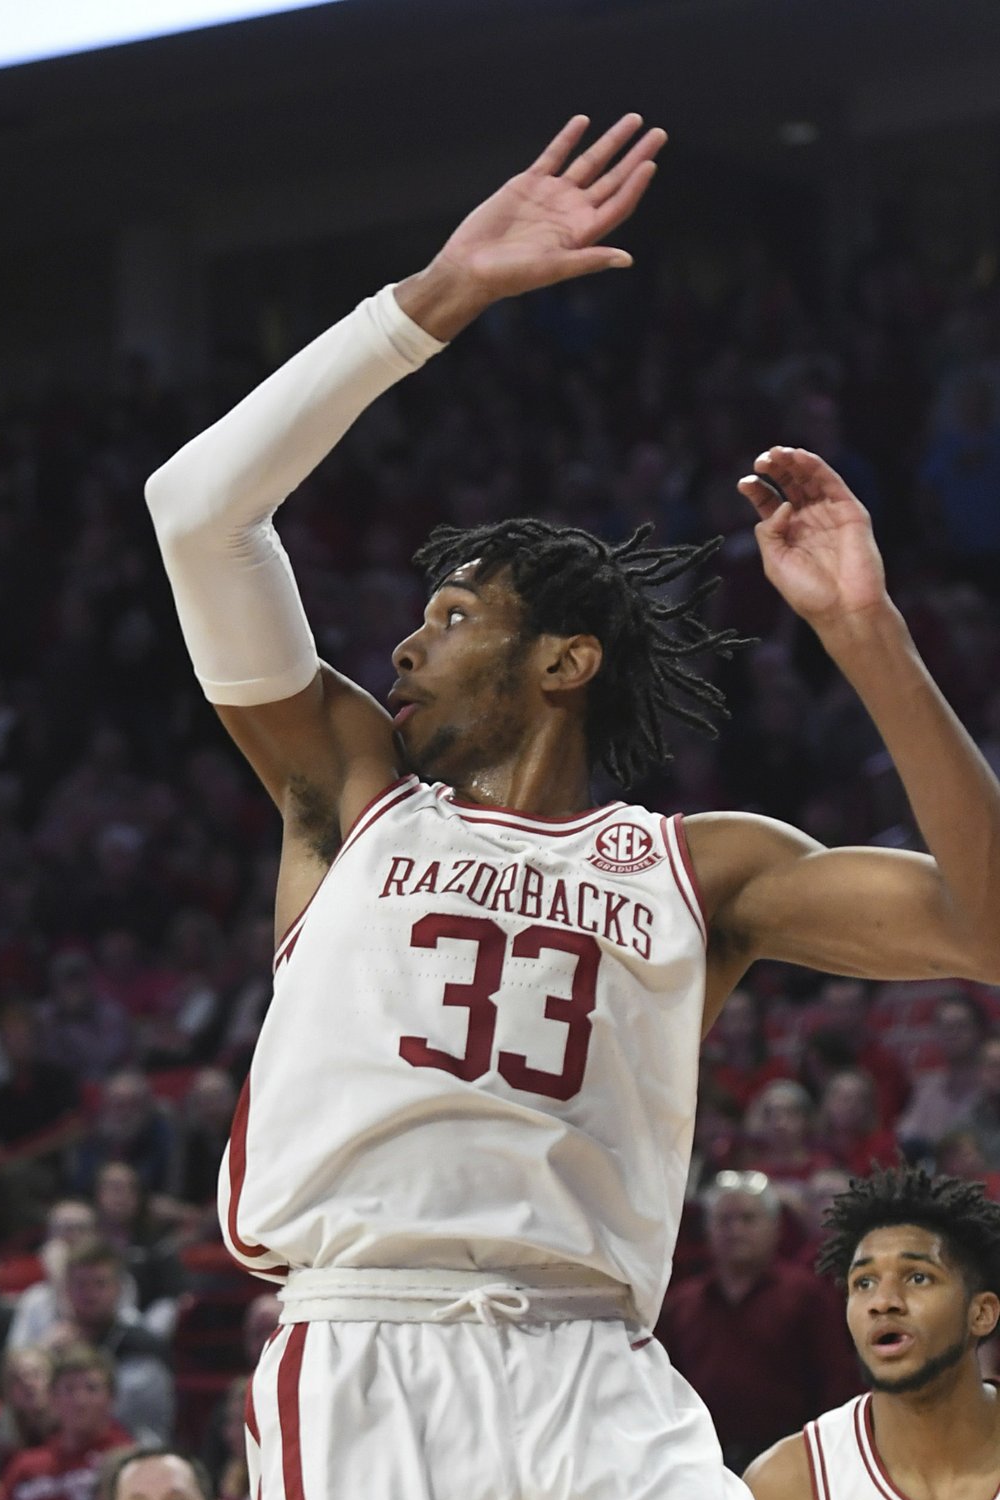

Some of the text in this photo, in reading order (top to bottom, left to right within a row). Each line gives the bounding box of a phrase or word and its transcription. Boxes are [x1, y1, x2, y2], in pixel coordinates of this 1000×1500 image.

[595, 856, 653, 873] GRADUATE
[600, 825, 649, 861] SEC
[378, 856, 654, 961] RAZORBACKS
[399, 912, 602, 1102] 33
